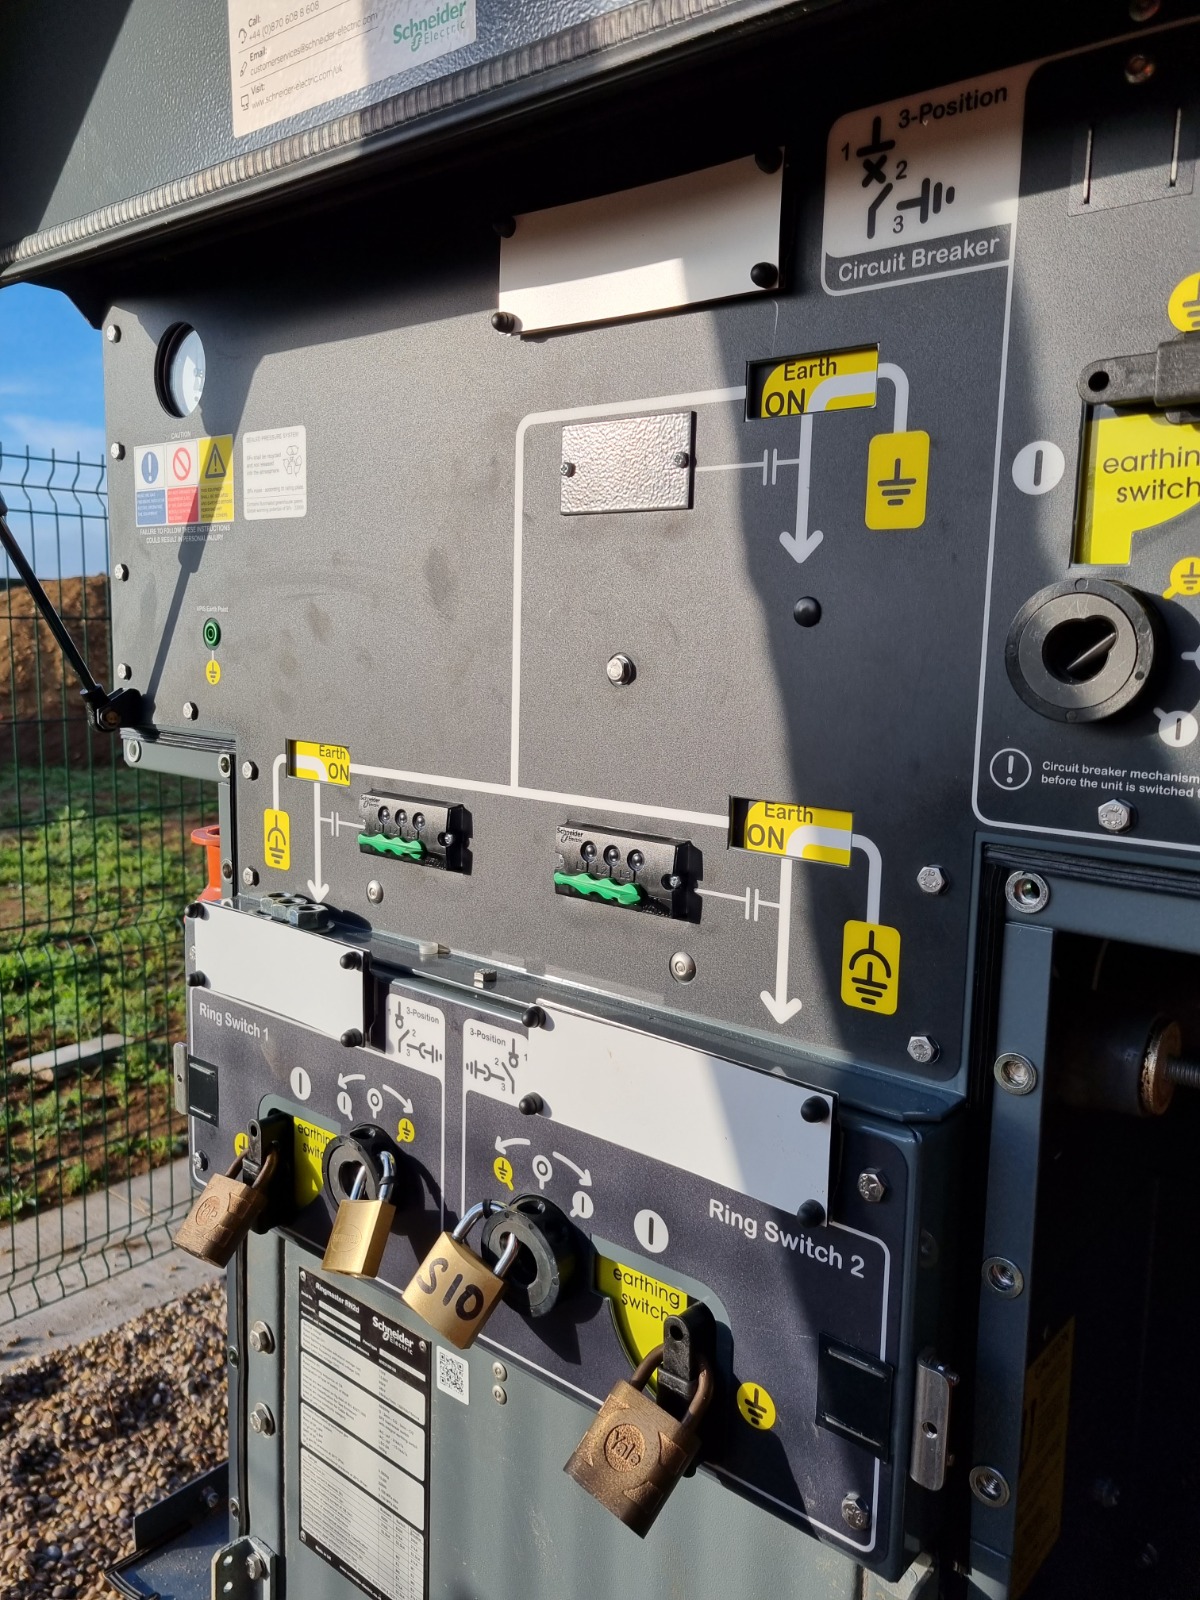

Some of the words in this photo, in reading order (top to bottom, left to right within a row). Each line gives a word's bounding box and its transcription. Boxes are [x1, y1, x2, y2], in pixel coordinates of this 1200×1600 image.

[248, 15, 261, 28] Call:
[249, 29, 260, 40] +44
[262, 18, 284, 38] (0)870
[285, 11, 299, 25] 608
[299, 8, 305, 18] 8
[305, 1, 320, 15] 608
[393, 1, 467, 45] Schneider
[250, 12, 378, 76] customerservices@schneider-electric.com
[424, 20, 466, 46] Electric
[249, 47, 267, 62] Email:
[251, 83, 265, 96] Visit:
[898, 87, 1008, 129] 3-Position
[841, 142, 850, 161] 1
[895, 160, 908, 180] 2
[892, 215, 904, 234] 3
[838, 252, 905, 282] Circuit
[911, 237, 1000, 269] Breaker
[784, 357, 837, 381] Earth
[765, 388, 806, 417] ON
[1116, 477, 1200, 503] switch
[319, 744, 346, 760] Earth
[328, 762, 349, 782] ON
[1042, 761, 1079, 774] Circuit
[1082, 764, 1127, 778] breaker
[1130, 768, 1200, 784] mechanism
[1041, 774, 1077, 786] before
[1080, 777, 1098, 788] the
[1101, 780, 1123, 791] unit
[1125, 782, 1136, 792] is
[1139, 784, 1194, 798] switched
[764, 803, 813, 824] Earth
[748, 824, 784, 850] ON
[200, 1002, 222, 1027] Ring
[225, 1012, 260, 1038] Switch
[263, 1027, 269, 1041] 1
[406, 1006, 439, 1024] 3-Position
[412, 1029, 417, 1037] 2
[470, 1028, 506, 1046] 3-Position
[406, 1049, 410, 1057] 3
[494, 1058, 499, 1066] 2
[524, 1053, 528, 1061] 1
[501, 1083, 505, 1091] 3
[709, 1199, 758, 1239] Ring
[764, 1221, 843, 1270] Switch
[850, 1256, 865, 1279] 2
[316, 1282, 344, 1303] Ringmaster
[613, 1268, 680, 1309] earthing
[372, 1316, 414, 1348] Schneider
[611, 1430, 641, 1467] Yale
